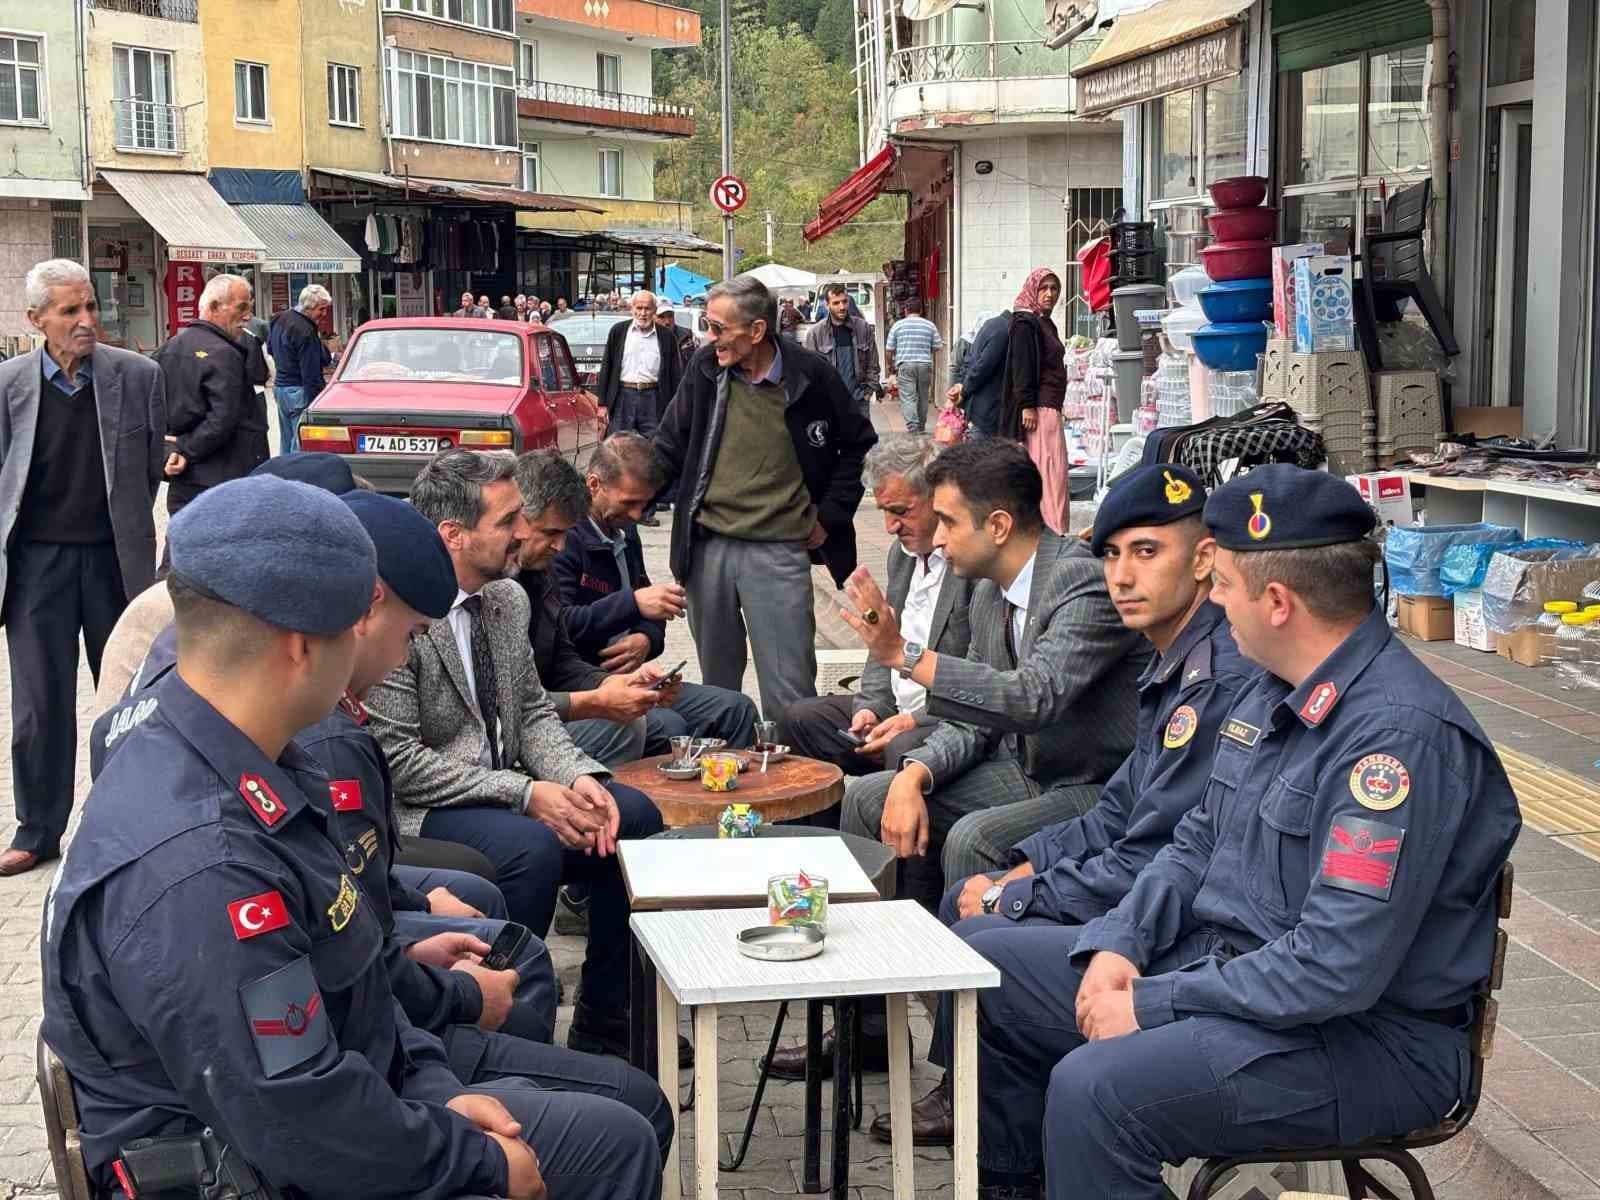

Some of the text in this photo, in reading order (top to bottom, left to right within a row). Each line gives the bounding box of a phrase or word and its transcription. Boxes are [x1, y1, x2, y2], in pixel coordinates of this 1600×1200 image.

[176, 266, 196, 334] RBE
[367, 437, 436, 452] 74 AD 537
